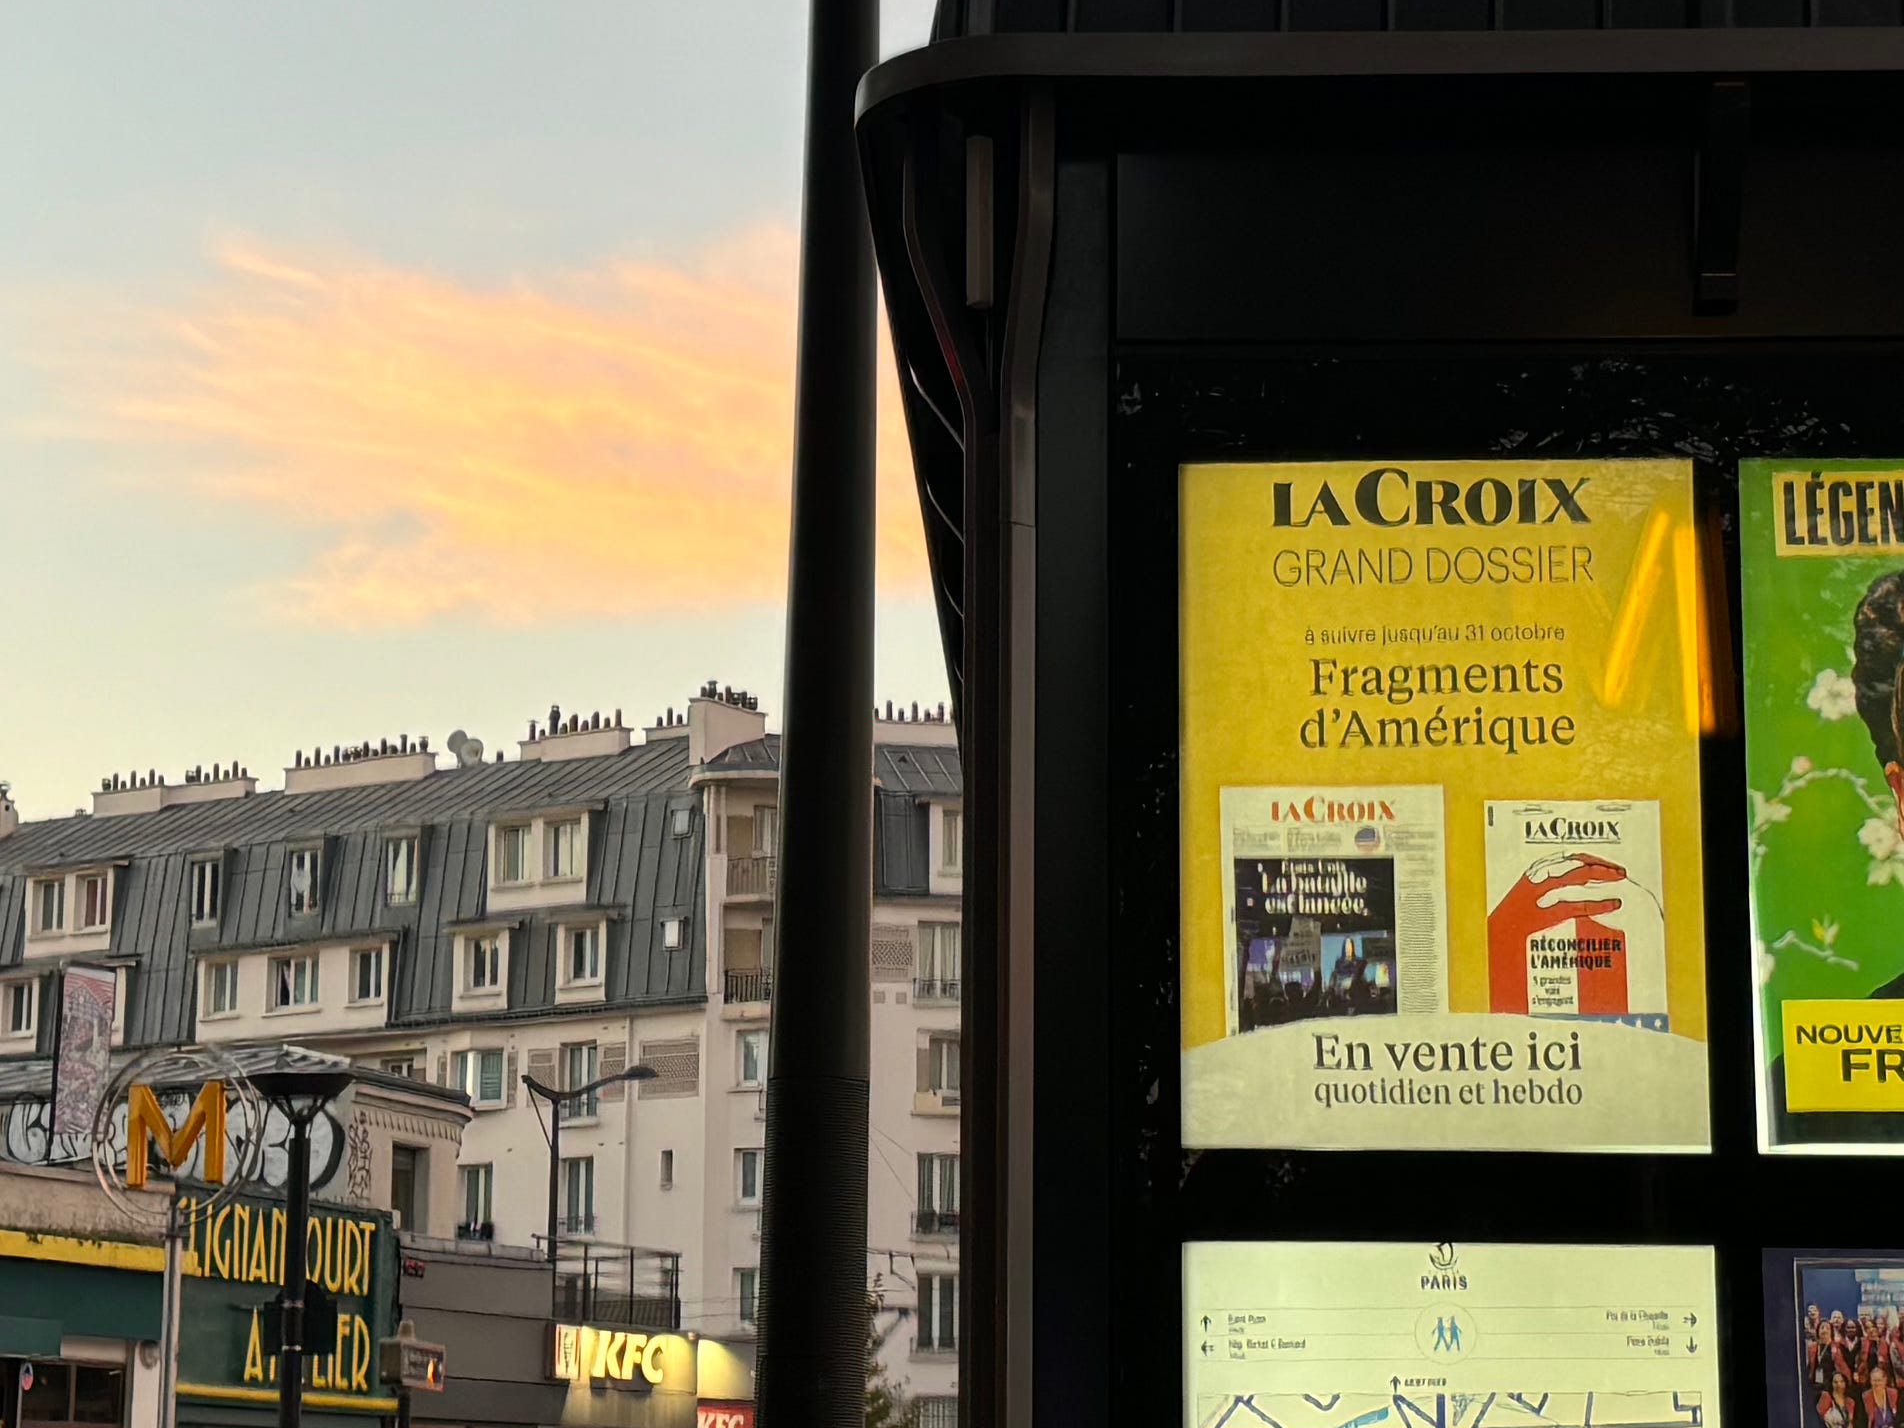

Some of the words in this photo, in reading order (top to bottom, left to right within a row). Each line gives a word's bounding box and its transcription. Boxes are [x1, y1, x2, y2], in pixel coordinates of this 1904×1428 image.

[1273, 547, 1413, 586] GRAND
[1428, 545, 1594, 584] DOSSIER
[1305, 626, 1314, 645] à
[1321, 627, 1376, 644] suivre
[1382, 624, 1459, 645] jusqu'au
[1465, 623, 1484, 641] 31
[1491, 622, 1565, 641] octobre
[1310, 656, 1563, 704] Fragments
[1299, 705, 1575, 755] d’Amérique
[1531, 937, 1621, 951] RÉCONCILIER
[1314, 1033, 1372, 1071] En
[1388, 1037, 1513, 1072] vente
[1527, 1031, 1582, 1069] ici
[1314, 1077, 1451, 1107] quotidien
[1459, 1079, 1486, 1106] et
[1493, 1077, 1583, 1106] hebdo
[126, 1080, 225, 1187] M
[1421, 1275, 1468, 1291] PARIS
[591, 1330, 663, 1383] KFC
